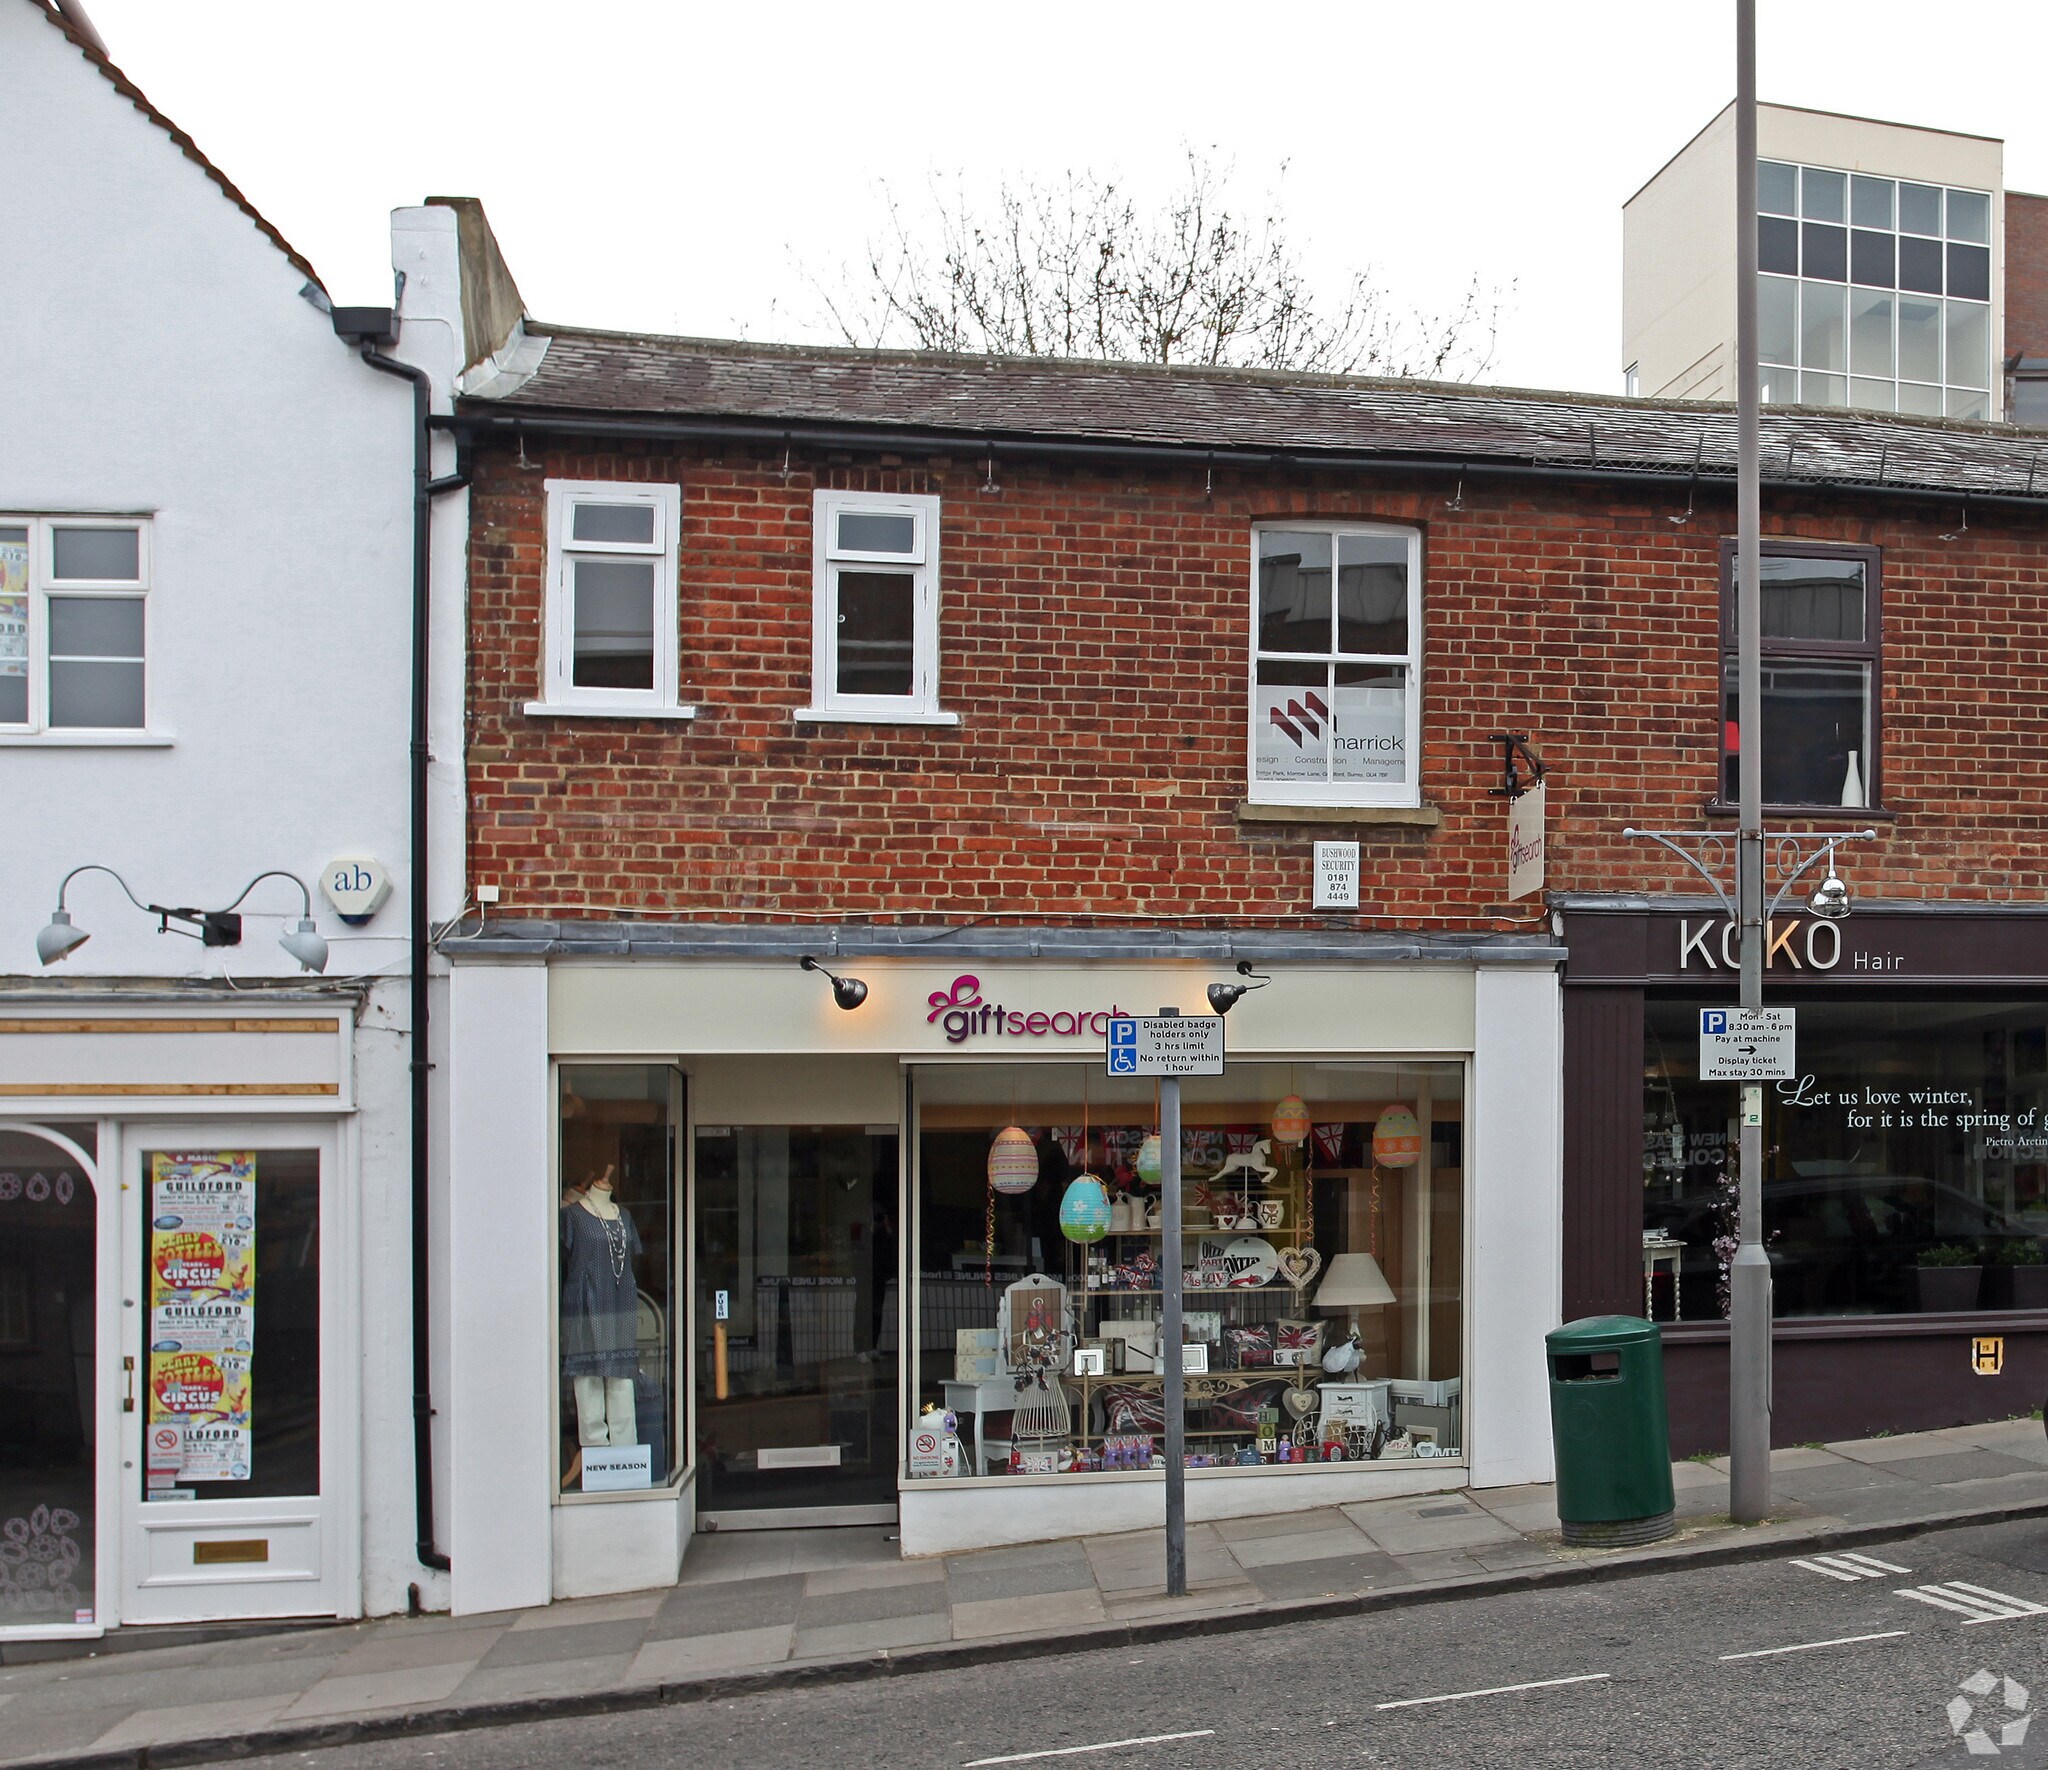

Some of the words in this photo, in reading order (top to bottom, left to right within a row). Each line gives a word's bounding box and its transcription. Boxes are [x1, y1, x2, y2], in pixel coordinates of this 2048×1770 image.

[1295, 756, 1347, 765] Constrution
[1322, 848, 1356, 858] BUSHWOOD
[1322, 861, 1355, 870] SECURITY
[335, 864, 372, 891] ab
[1330, 883, 1346, 891] 874
[1854, 951, 1904, 969] Hair
[1143, 1021, 1184, 1029] Disabled
[1188, 1021, 1216, 1030] badge
[1708, 1013, 1723, 1032] P
[1117, 1024, 1133, 1043] P
[1189, 1031, 1209, 1039] only
[1155, 1042, 1160, 1050] 3
[1183, 1042, 1204, 1050] limit
[1190, 1054, 1219, 1062] within
[1719, 1057, 1749, 1065] Display
[1776, 1074, 1831, 1106] Let
[1839, 1092, 1858, 1104] us
[1865, 1086, 1901, 1105] love
[1908, 1086, 1973, 1106] winter,
[1847, 1109, 1873, 1127] for
[1880, 1110, 1892, 1127] it
[1900, 1110, 1913, 1127] is
[1920, 1108, 1948, 1127] the
[1956, 1109, 2010, 1132] spring
[2017, 1107, 2037, 1126] of
[1986, 1136, 2014, 1146] Pietro
[2017, 1136, 2048, 1146] Aretin
[166, 1182, 242, 1191] GUILDFORD
[163, 1268, 221, 1279] CIRCUS
[165, 1306, 241, 1316] GUILDFORD
[161, 1391, 220, 1403] CIRCUS
